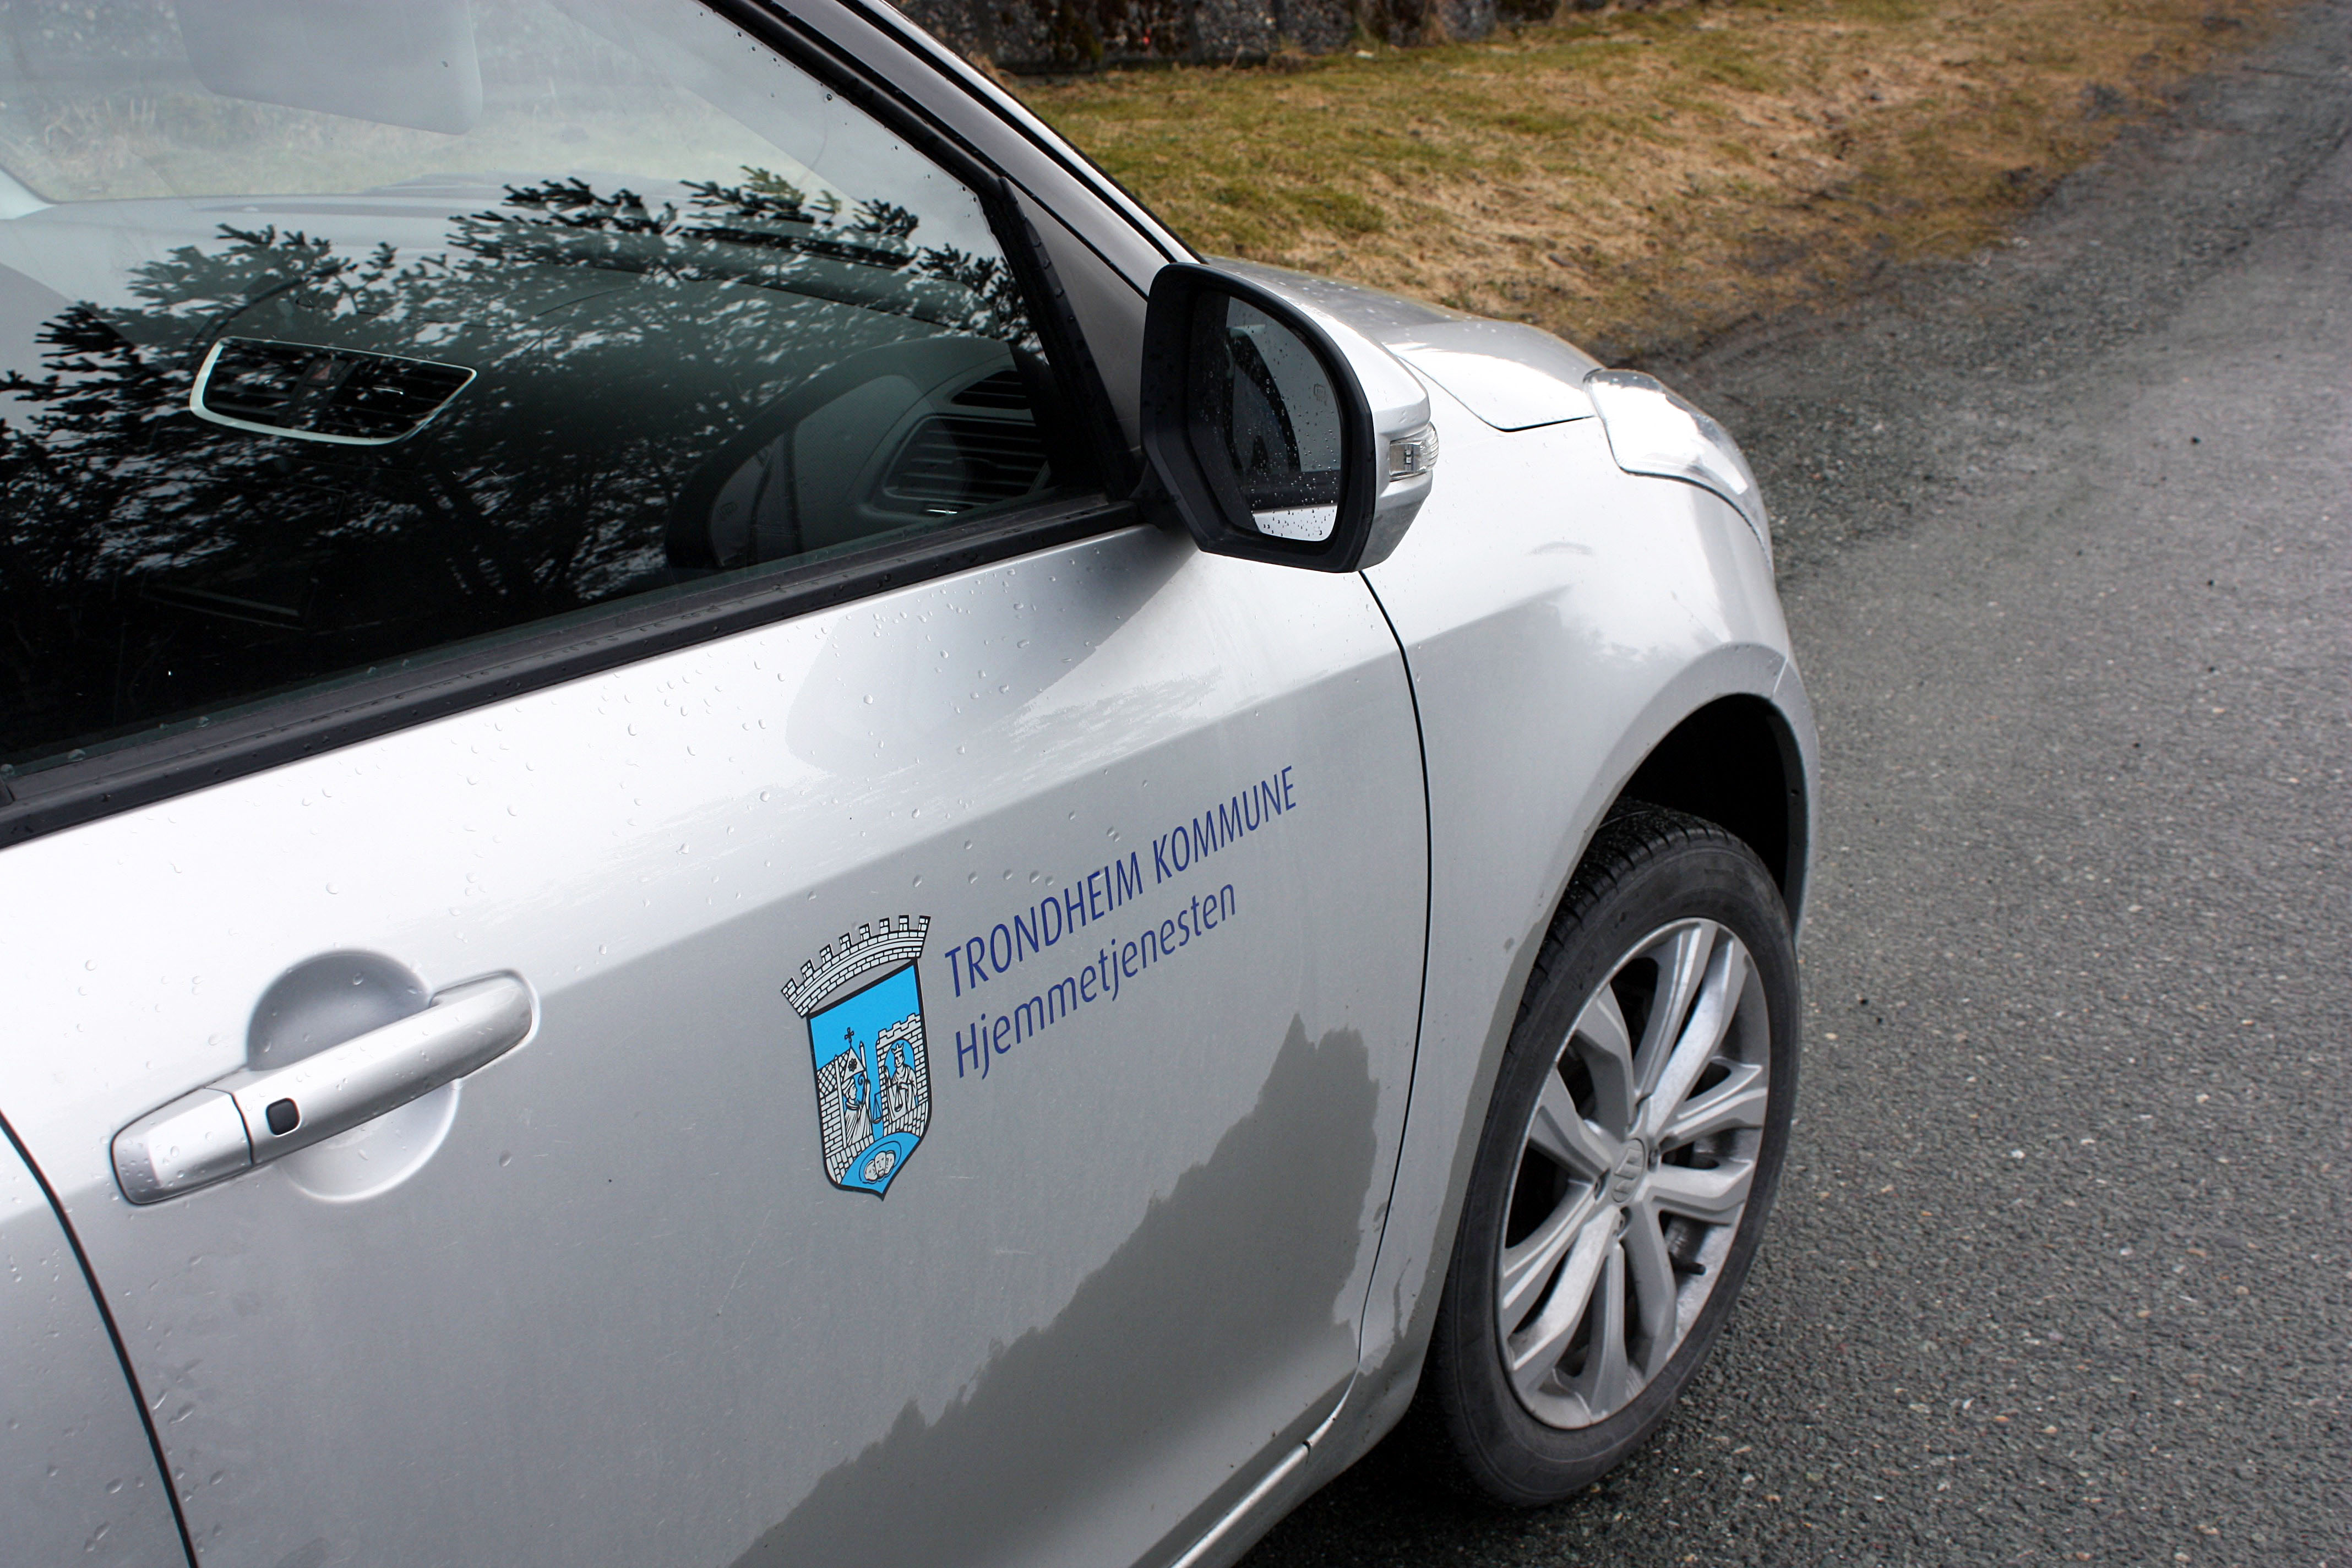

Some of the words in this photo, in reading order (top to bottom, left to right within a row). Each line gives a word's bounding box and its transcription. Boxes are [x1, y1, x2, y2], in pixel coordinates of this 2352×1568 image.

[944, 851, 1144, 998] TRONDHEIM
[1152, 765, 1297, 884] KOMMUNE
[954, 884, 1237, 1079] Hjemmetjenesten
